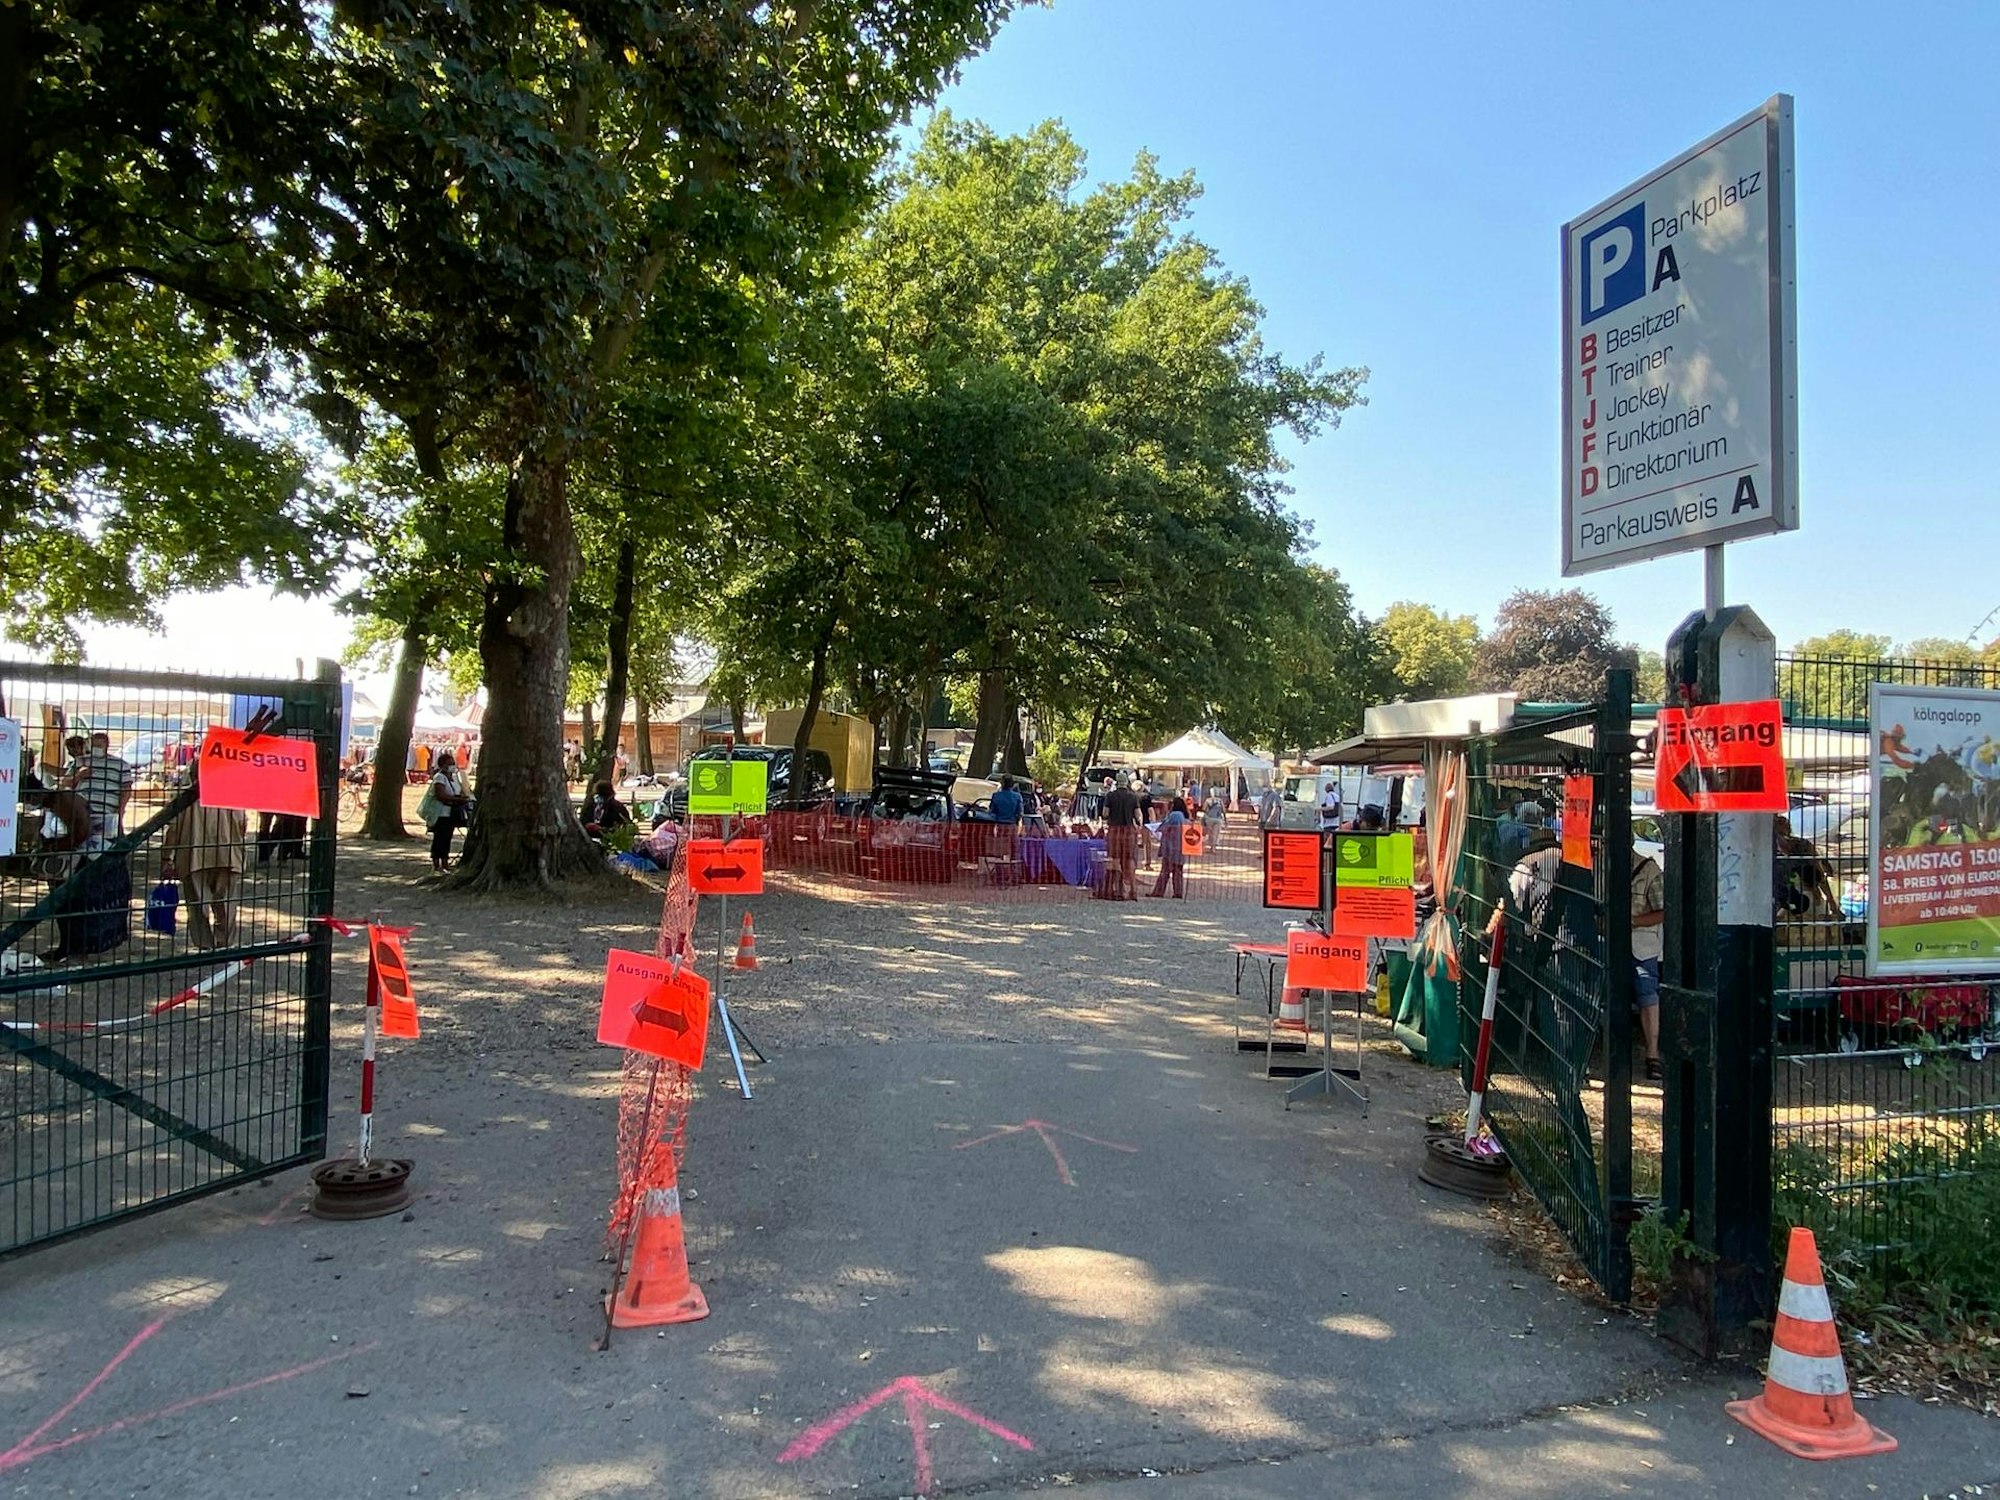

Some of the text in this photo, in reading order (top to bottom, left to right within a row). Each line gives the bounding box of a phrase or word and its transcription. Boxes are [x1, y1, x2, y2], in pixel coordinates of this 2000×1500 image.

[1651, 171, 1762, 246] Parkplatz
[1589, 226, 1633, 313] P
[1652, 243, 1681, 292] A
[1581, 304, 1685, 365] B Besitzer
[1582, 345, 1673, 396] T Trainer
[1582, 383, 1670, 430] J Jockey
[1582, 404, 1712, 463] F Funktionär
[1581, 437, 1727, 497] D Direktorium
[1581, 475, 1760, 549] Parkausweis A
[1665, 721, 1776, 748] Eingang
[1913, 707, 1982, 726] kölngalopp
[208, 741, 307, 772] Ausgang
[1883, 848, 2000, 873] SAMSTAG 15.0
[1883, 879, 1901, 890] 58.
[1903, 876, 1938, 889] PREIS
[1940, 873, 1965, 885] VON
[1883, 891, 1942, 905] LIVESTREAM
[1943, 889, 1963, 900] AUF
[616, 963, 670, 985] Ausgang
[1294, 943, 1362, 961] Eingang
